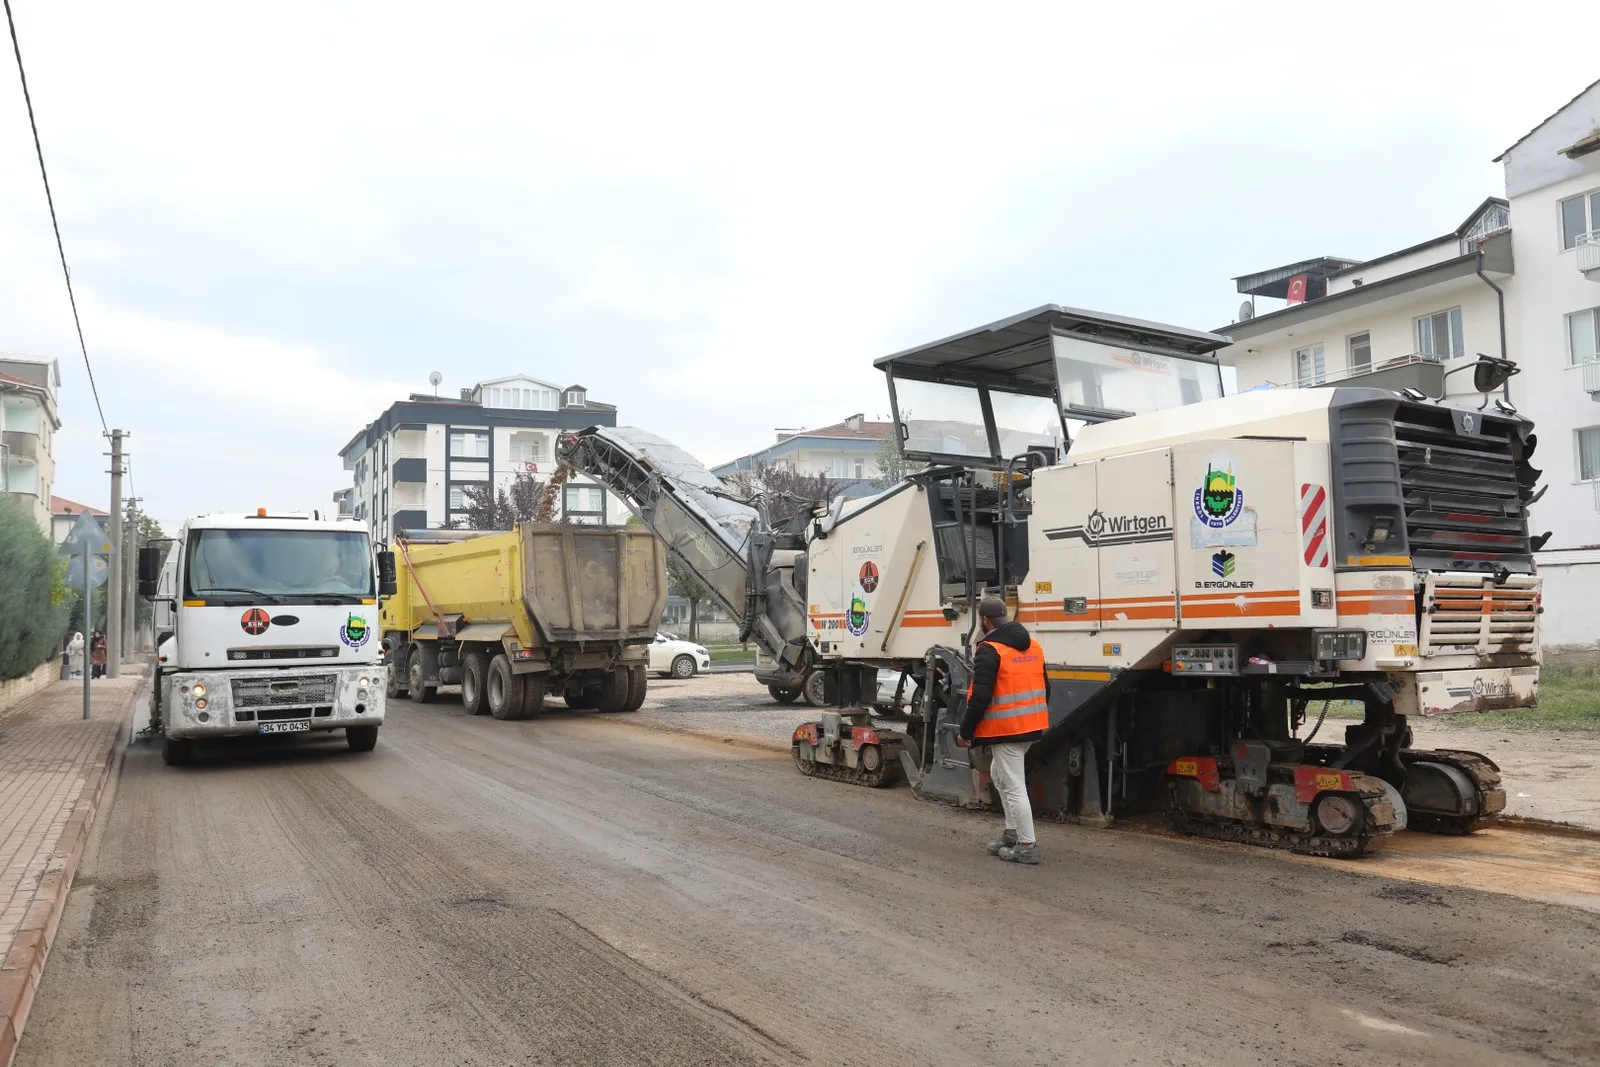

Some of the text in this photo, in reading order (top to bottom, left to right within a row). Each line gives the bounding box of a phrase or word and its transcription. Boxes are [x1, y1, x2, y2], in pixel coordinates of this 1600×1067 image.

[1108, 515, 1166, 534] Wirtgen
[264, 721, 309, 732] 34 YC 0435
